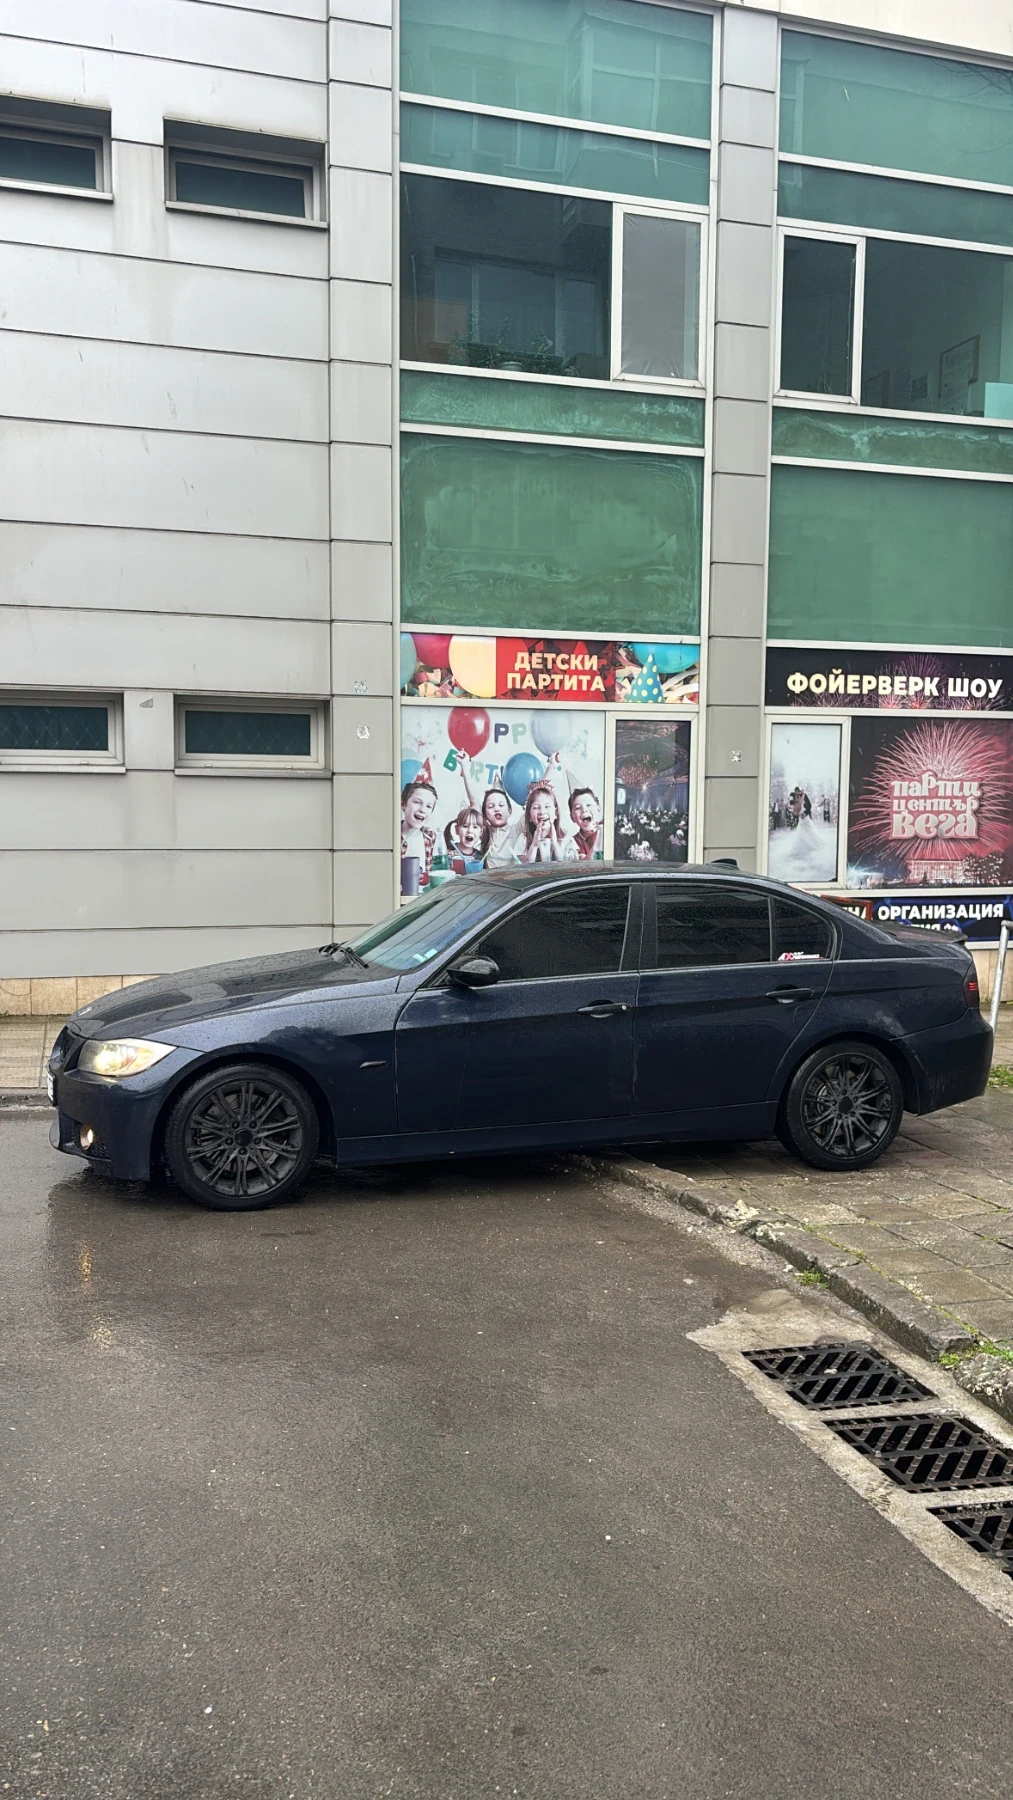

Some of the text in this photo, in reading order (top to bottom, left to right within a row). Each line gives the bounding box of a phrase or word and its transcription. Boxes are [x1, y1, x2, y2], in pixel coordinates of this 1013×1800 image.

[514, 651, 599, 671] ДЕТСКИ
[506, 672, 606, 692] ПАРТИТА
[787, 668, 1004, 699] ФОЙЕРВЕРК ШОУ
[878, 903, 1004, 921] ОРГАНИЗАЦИЯ
